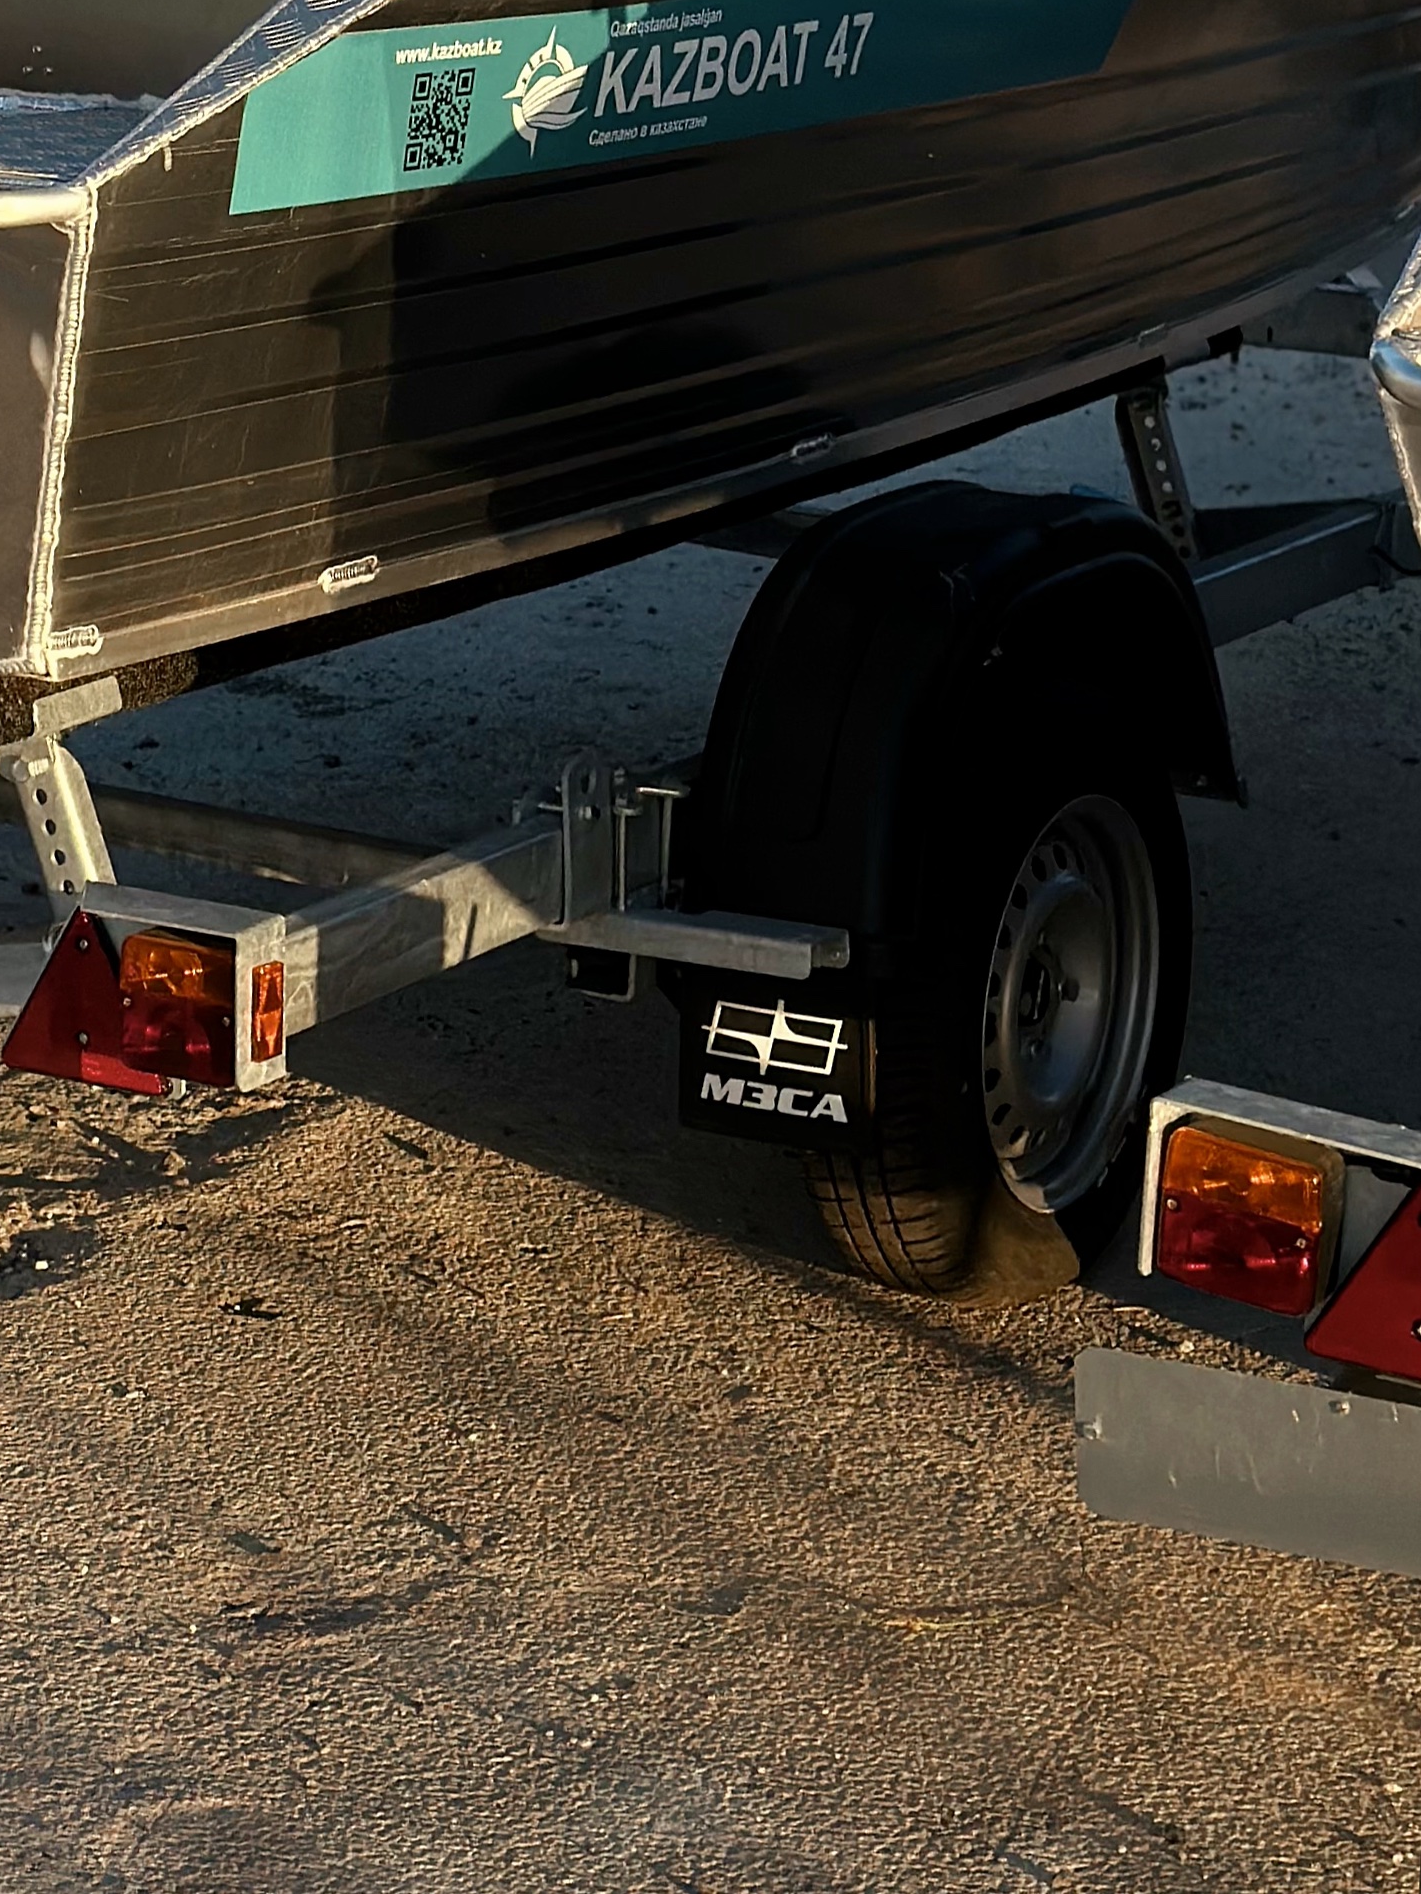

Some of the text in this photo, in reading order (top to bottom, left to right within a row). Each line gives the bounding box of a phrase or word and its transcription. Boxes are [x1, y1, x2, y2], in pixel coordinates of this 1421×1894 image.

[610, 16, 678, 38] Qazaqstanda
[395, 37, 503, 65] www.kazboat.kz
[594, 12, 875, 118] KAZBOAT 47
[589, 127, 638, 146] Сделано
